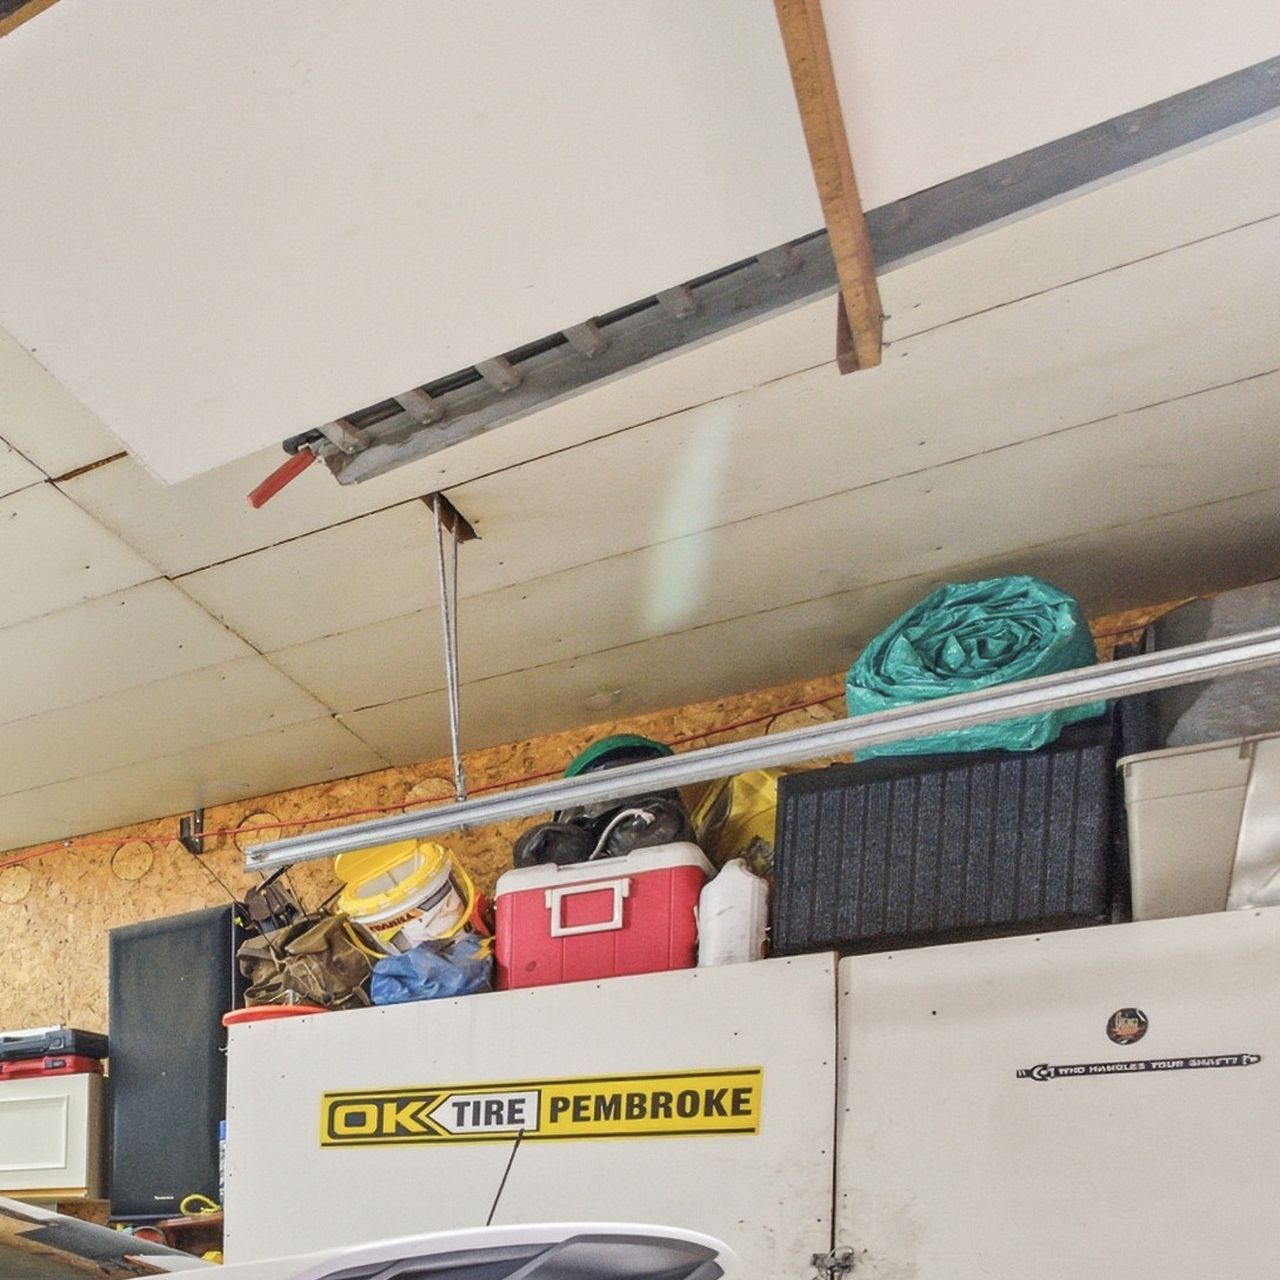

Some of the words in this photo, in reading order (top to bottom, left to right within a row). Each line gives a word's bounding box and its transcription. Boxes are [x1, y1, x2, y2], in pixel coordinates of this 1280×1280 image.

[333, 1101, 430, 1136] OK
[451, 1097, 526, 1128] TIRE
[548, 1086, 754, 1125] PEMBROKE
